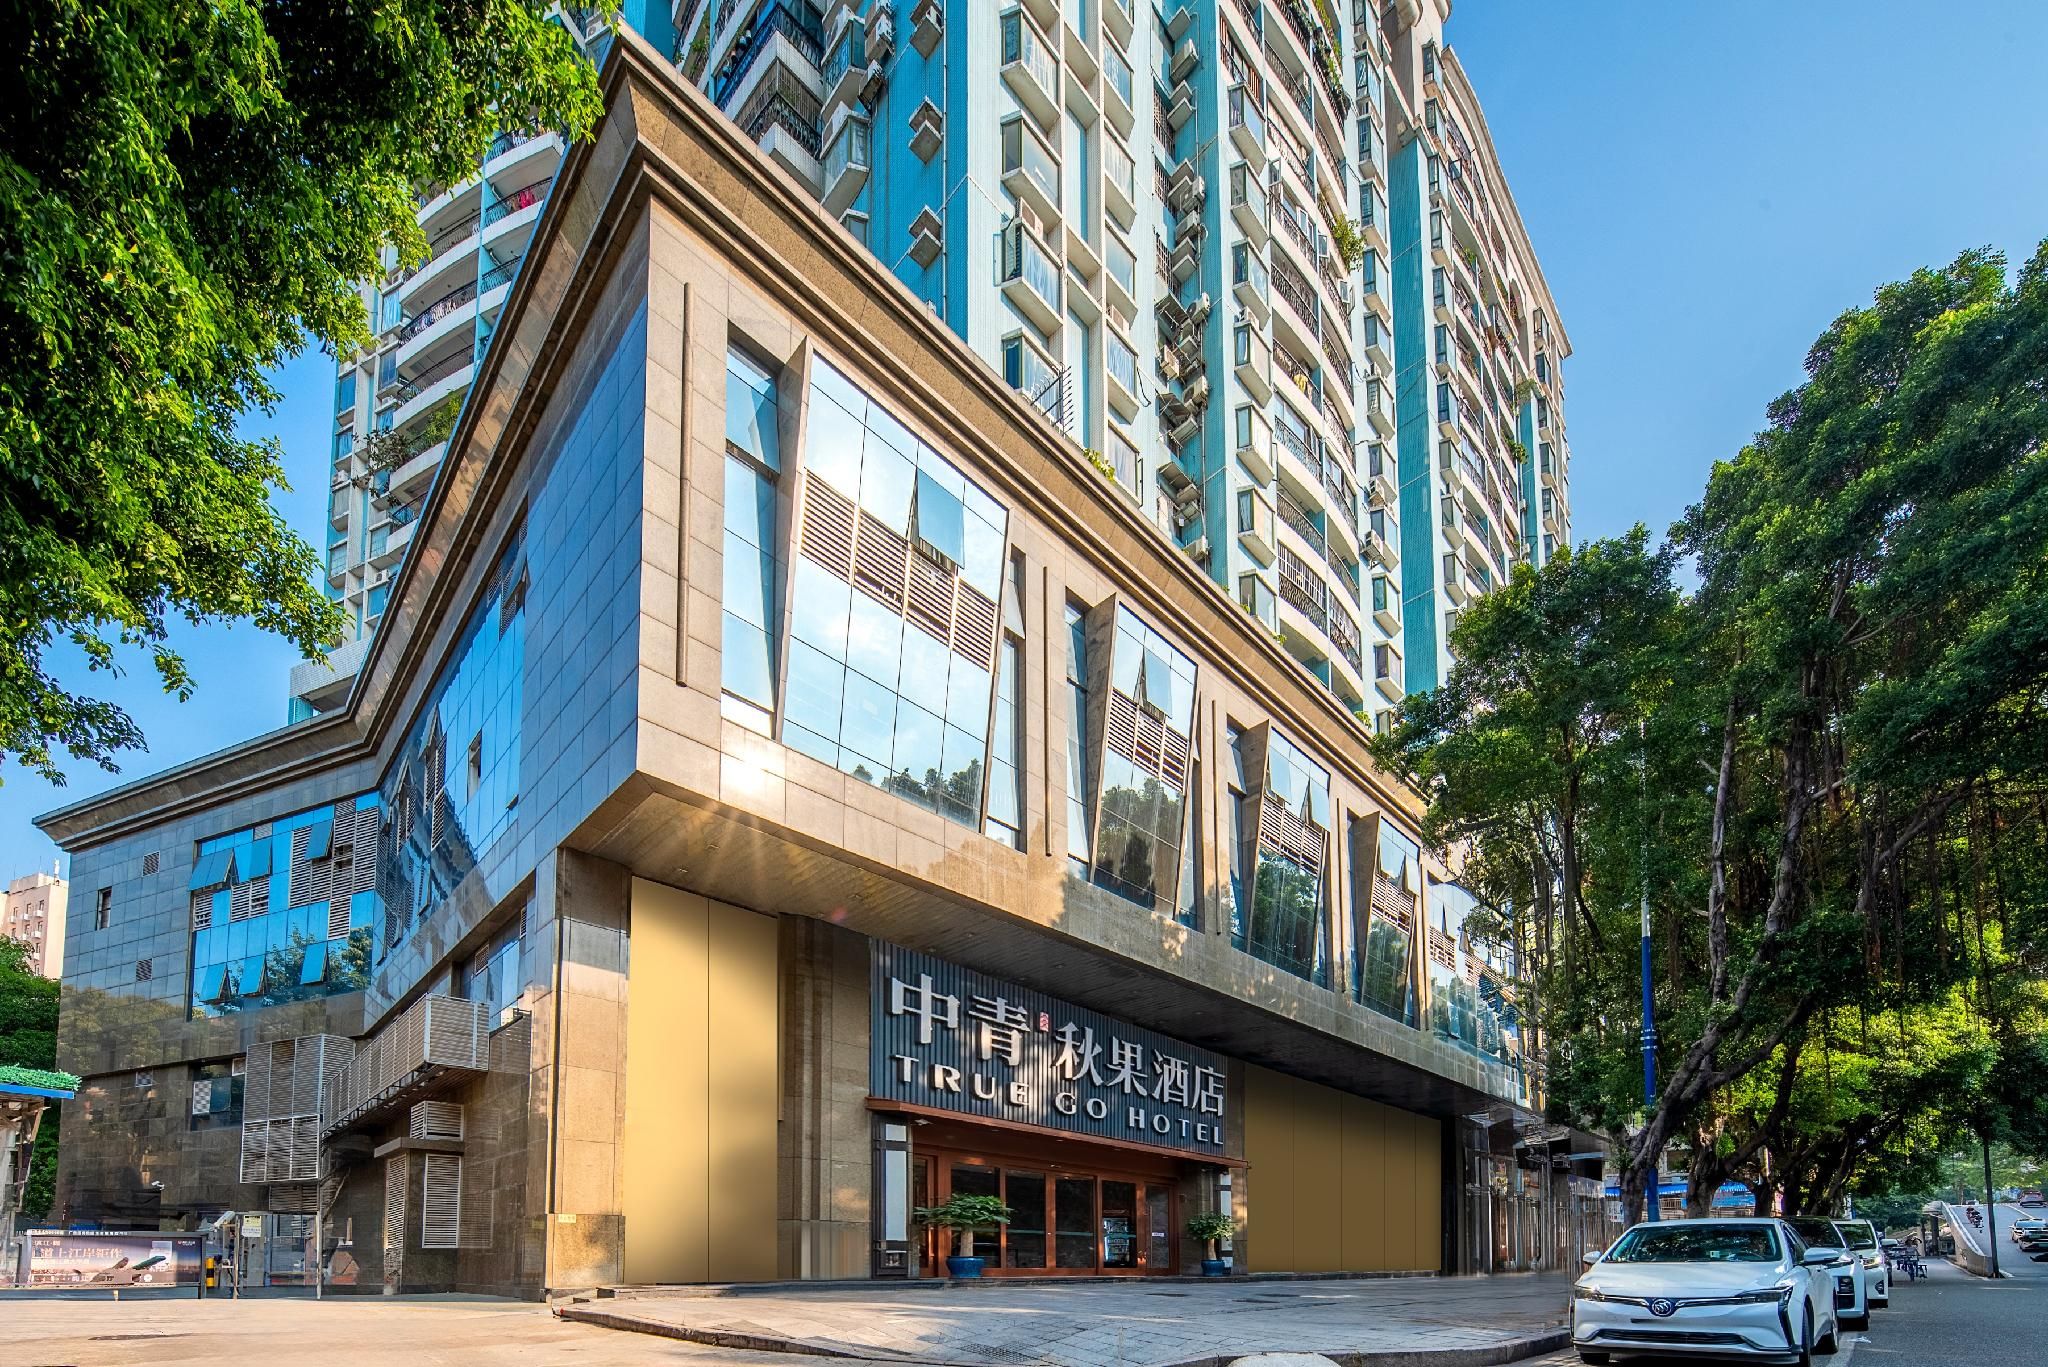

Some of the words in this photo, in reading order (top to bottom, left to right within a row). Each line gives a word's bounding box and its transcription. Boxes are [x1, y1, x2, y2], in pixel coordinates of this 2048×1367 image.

[895, 1054, 1030, 1106] TRUE
[1055, 1092, 1108, 1119] GO
[1128, 1106, 1224, 1145] HOTEL
